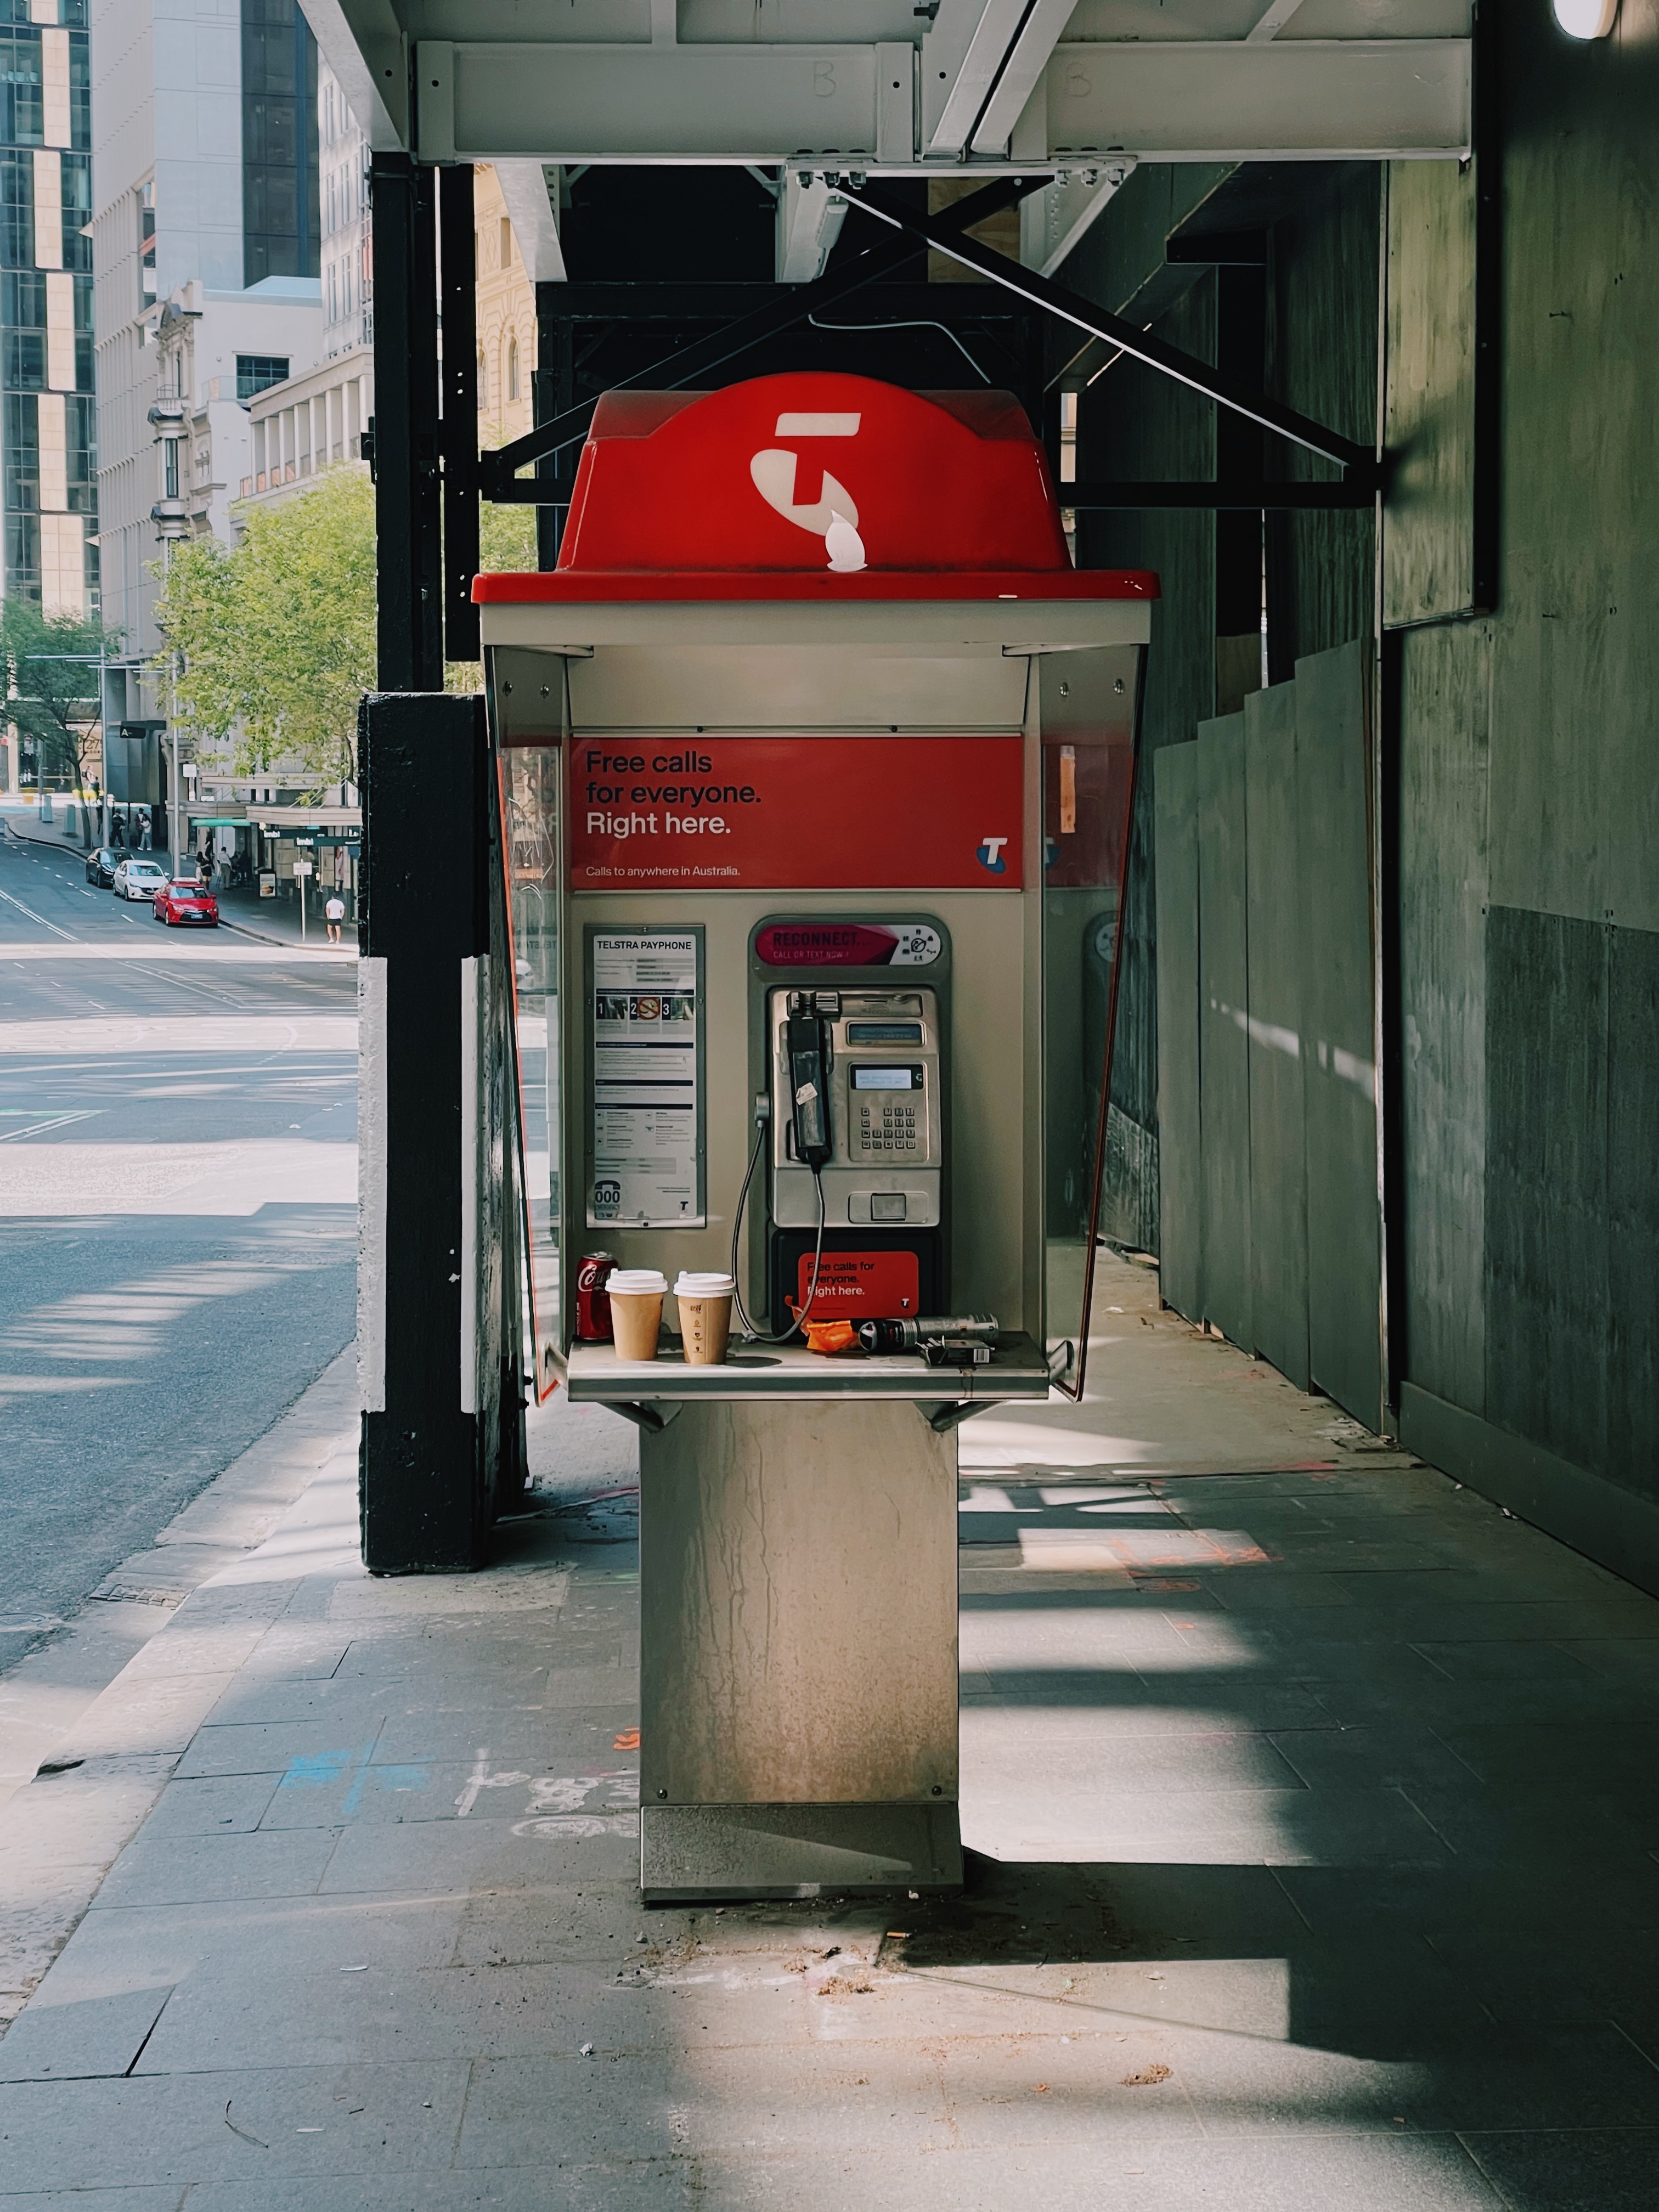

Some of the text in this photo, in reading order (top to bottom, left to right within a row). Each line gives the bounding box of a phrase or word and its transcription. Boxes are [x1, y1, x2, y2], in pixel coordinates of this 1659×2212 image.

[586, 751, 712, 773] Free calls
[586, 782, 761, 808] for everyone.
[587, 812, 731, 839] Right here.
[983, 837, 1008, 865] T
[586, 866, 741, 878] Calls to anywhere in Australia.
[773, 932, 871, 947] RECONNECT...
[597, 941, 692, 950] TELSTRA PAYPHONE
[598, 1003, 603, 1014] 1
[631, 1003, 637, 1014] 2
[663, 1004, 669, 1015] 3
[595, 1190, 620, 1203] 000
[680, 1201, 689, 1210] T
[833, 1262, 857, 1271] calls
[860, 1261, 875, 1271] for
[838, 1286, 865, 1295] here.
